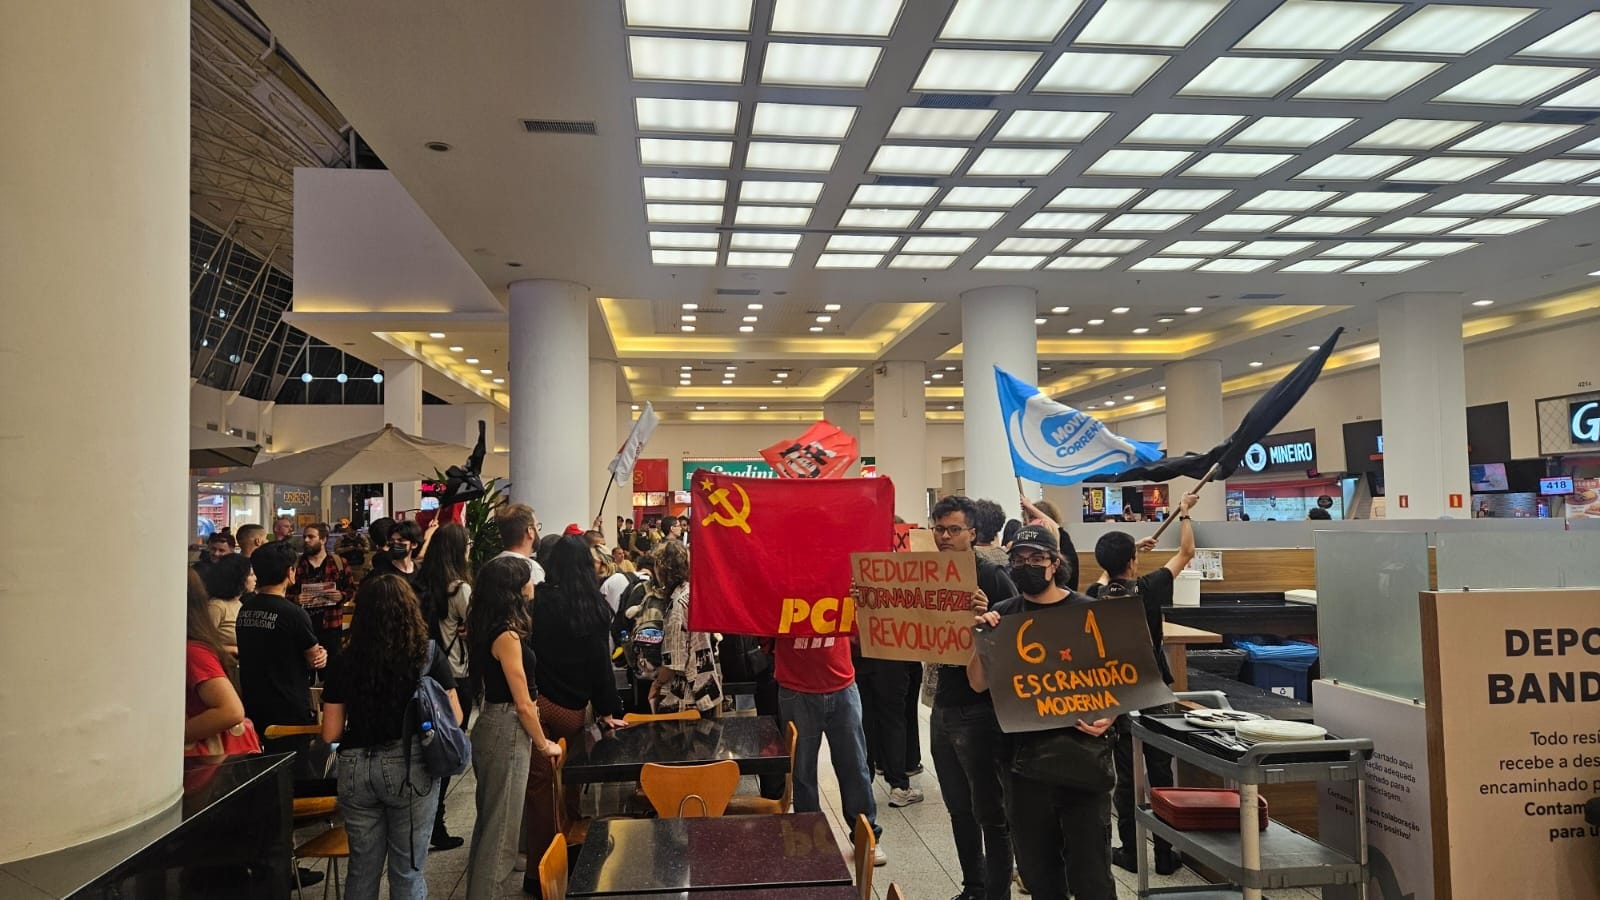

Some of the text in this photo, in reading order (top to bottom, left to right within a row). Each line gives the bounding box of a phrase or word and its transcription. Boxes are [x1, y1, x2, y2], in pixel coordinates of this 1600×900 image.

[1270, 442, 1313, 464] MINEIRO
[1546, 480, 1567, 490] 418
[859, 558, 961, 583] REDUZIR A
[869, 616, 973, 656] REVOLUÇÃO
[1016, 618, 1047, 664] 6
[1084, 608, 1106, 658] 1
[1013, 659, 1138, 698] ESCRAVIDÃO
[1487, 671, 1600, 705] BAND
[1037, 690, 1120, 717] MODERNA
[1530, 731, 1568, 746] Todo
[1499, 753, 1600, 770] recebe a des
[1479, 778, 1588, 795] encaminhado
[1550, 826, 1585, 842] para
